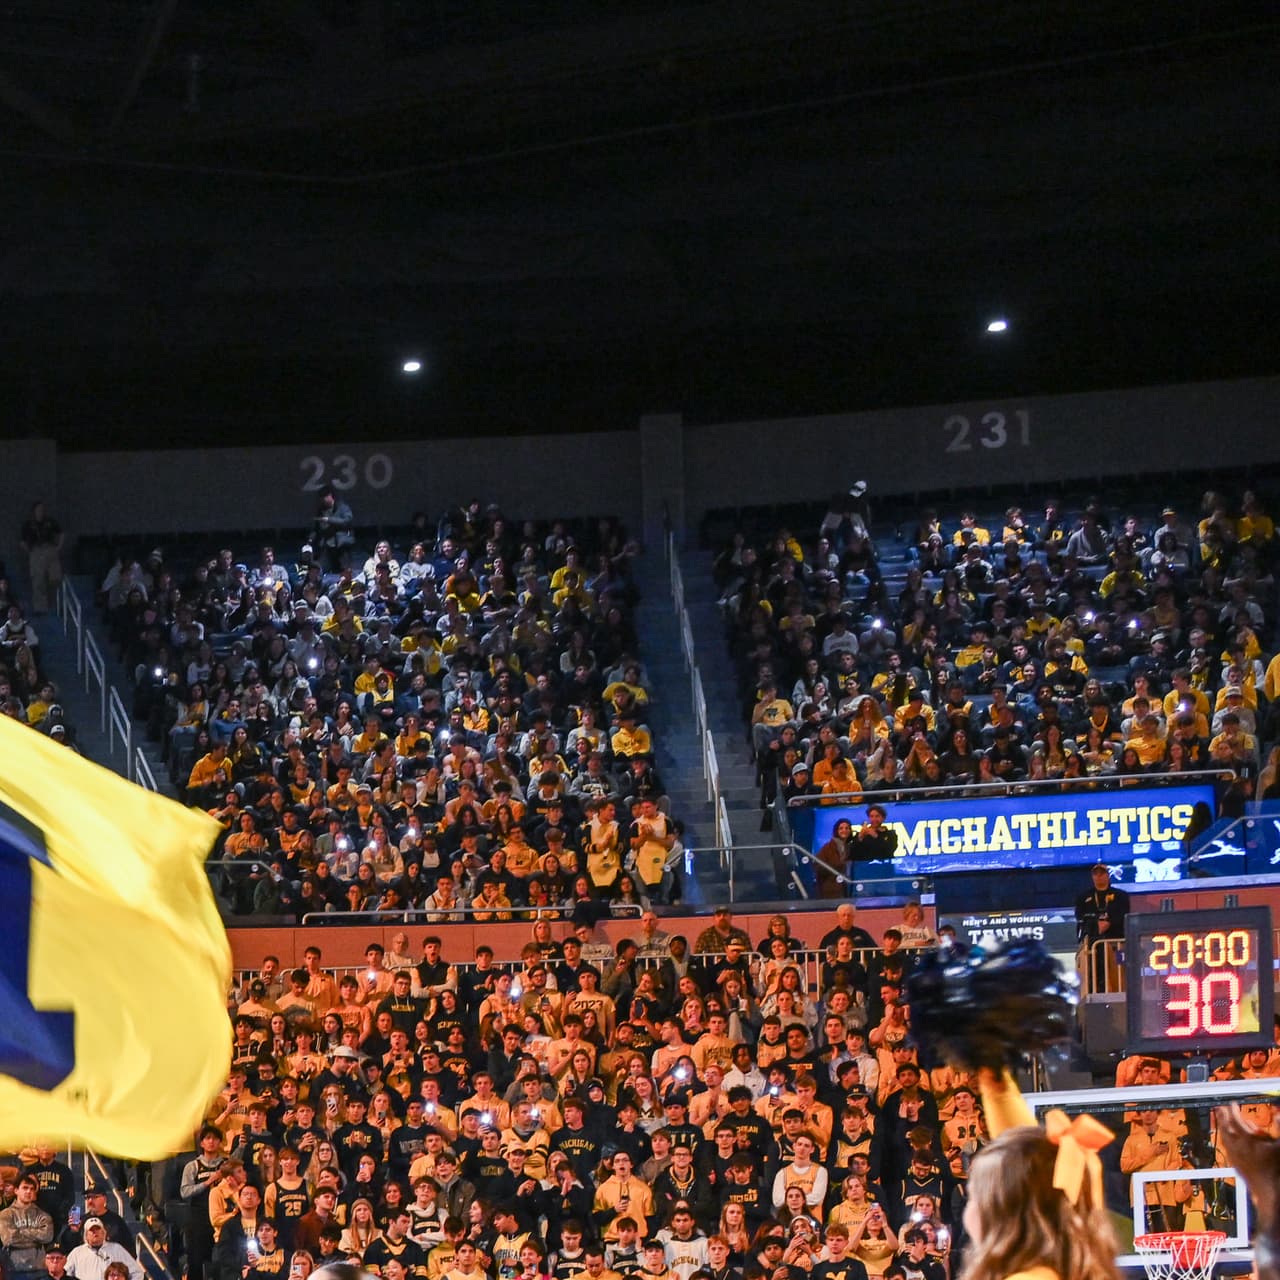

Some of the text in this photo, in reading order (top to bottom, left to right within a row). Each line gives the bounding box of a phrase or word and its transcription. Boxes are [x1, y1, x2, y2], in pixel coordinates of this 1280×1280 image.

[943, 410, 1033, 454] 231
[300, 452, 393, 492] 230
[851, 804, 1194, 858] MICHATHLETICS
[989, 917, 1008, 926] AND
[1009, 914, 1048, 925] WOMEN'S
[1149, 930, 1250, 972] 20:00
[574, 1000, 603, 1010] 2023
[1165, 971, 1240, 1038] 30
[559, 1137, 595, 1152] MICHIGAN
[285, 1201, 302, 1217] 25
